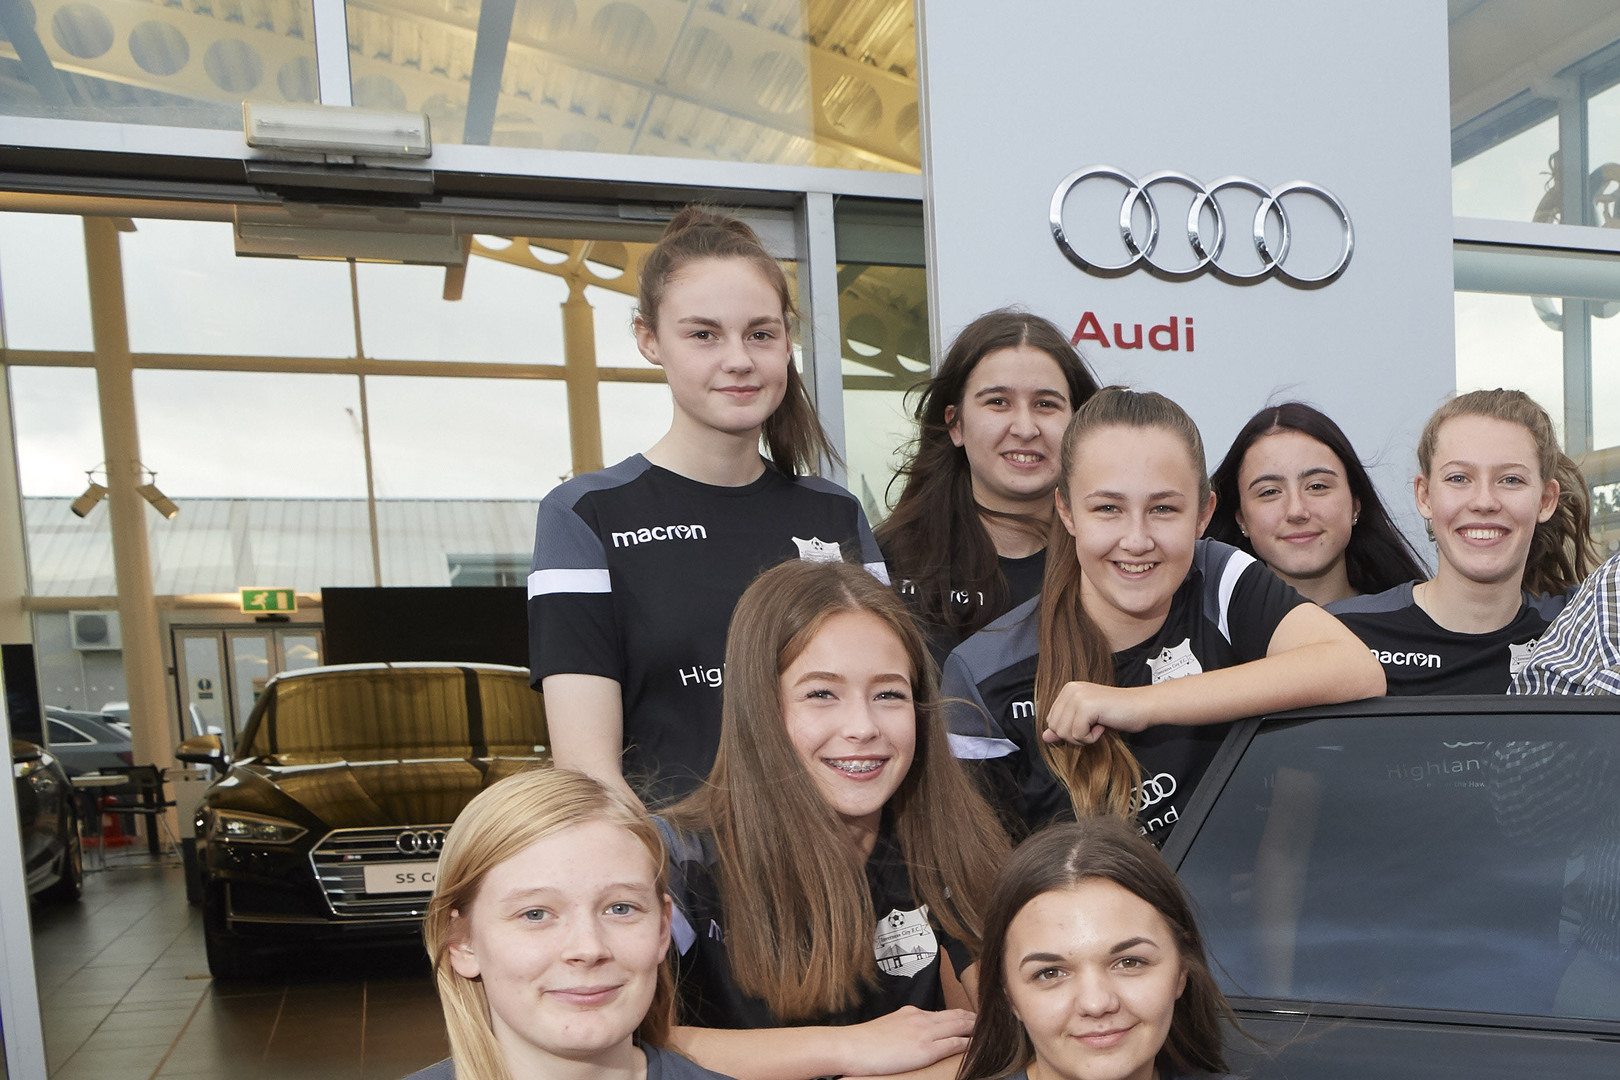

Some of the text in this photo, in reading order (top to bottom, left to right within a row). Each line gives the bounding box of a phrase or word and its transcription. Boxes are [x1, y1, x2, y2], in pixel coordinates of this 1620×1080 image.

[1070, 311, 1195, 353] Audi
[611, 523, 708, 548] macron
[396, 873, 415, 884] S5
